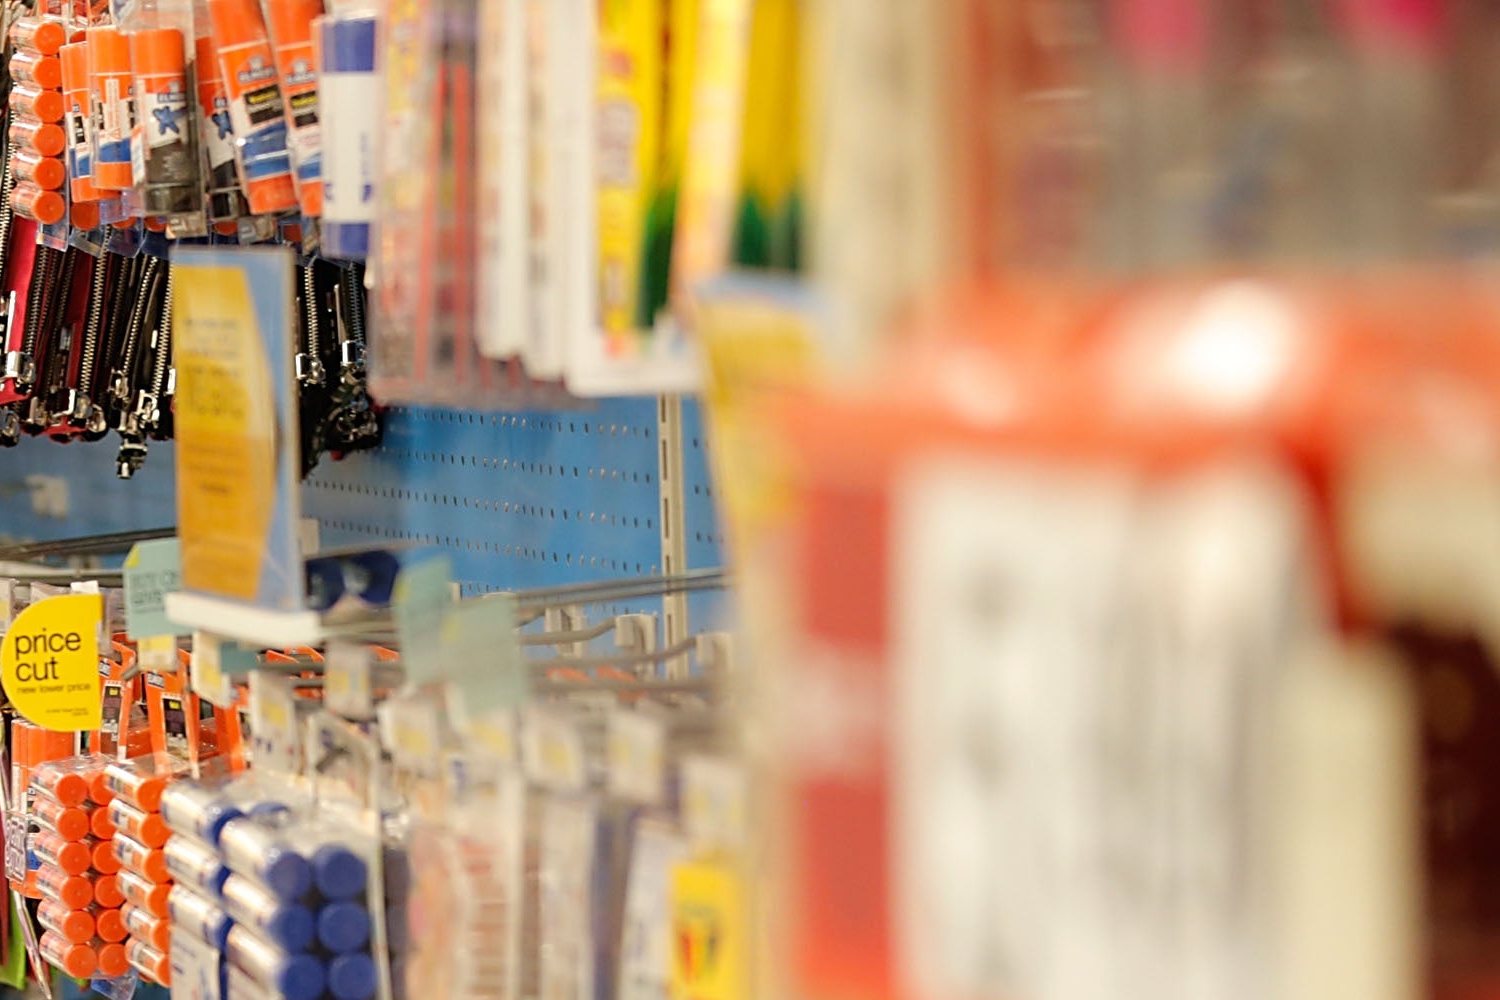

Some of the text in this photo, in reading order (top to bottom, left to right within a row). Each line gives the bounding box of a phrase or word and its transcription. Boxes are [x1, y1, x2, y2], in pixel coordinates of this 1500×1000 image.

[15, 627, 81, 661] price
[15, 657, 59, 682] cut
[39, 684, 64, 693] lower
[67, 683, 91, 693] price
